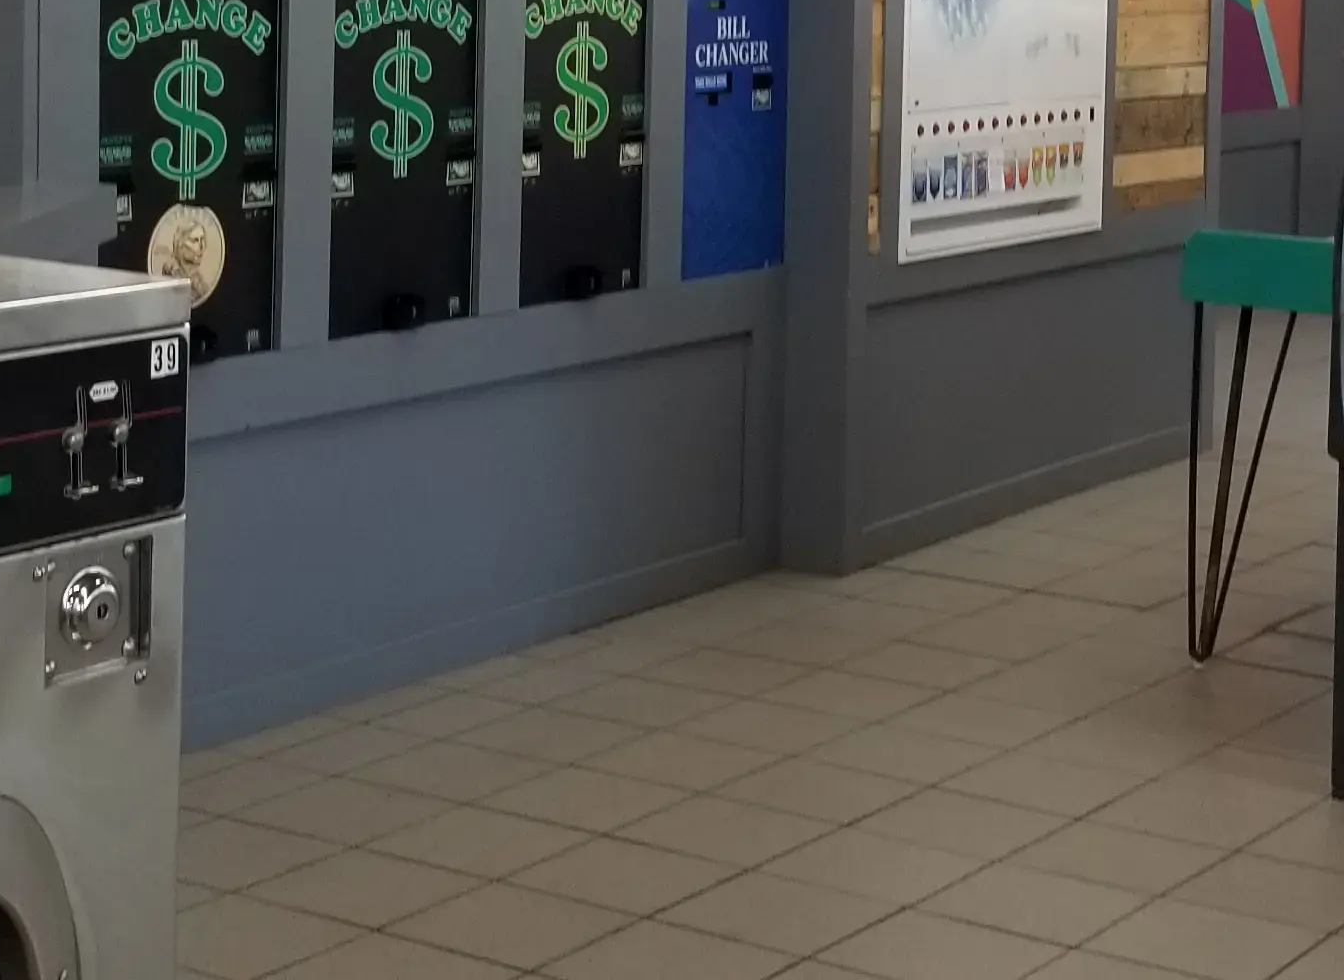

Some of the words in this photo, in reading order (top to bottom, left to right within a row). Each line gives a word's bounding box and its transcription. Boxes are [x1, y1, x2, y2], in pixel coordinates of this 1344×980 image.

[716, 14, 751, 41] BILL
[695, 40, 769, 69] CHANGER
[153, 342, 177, 372] 39
